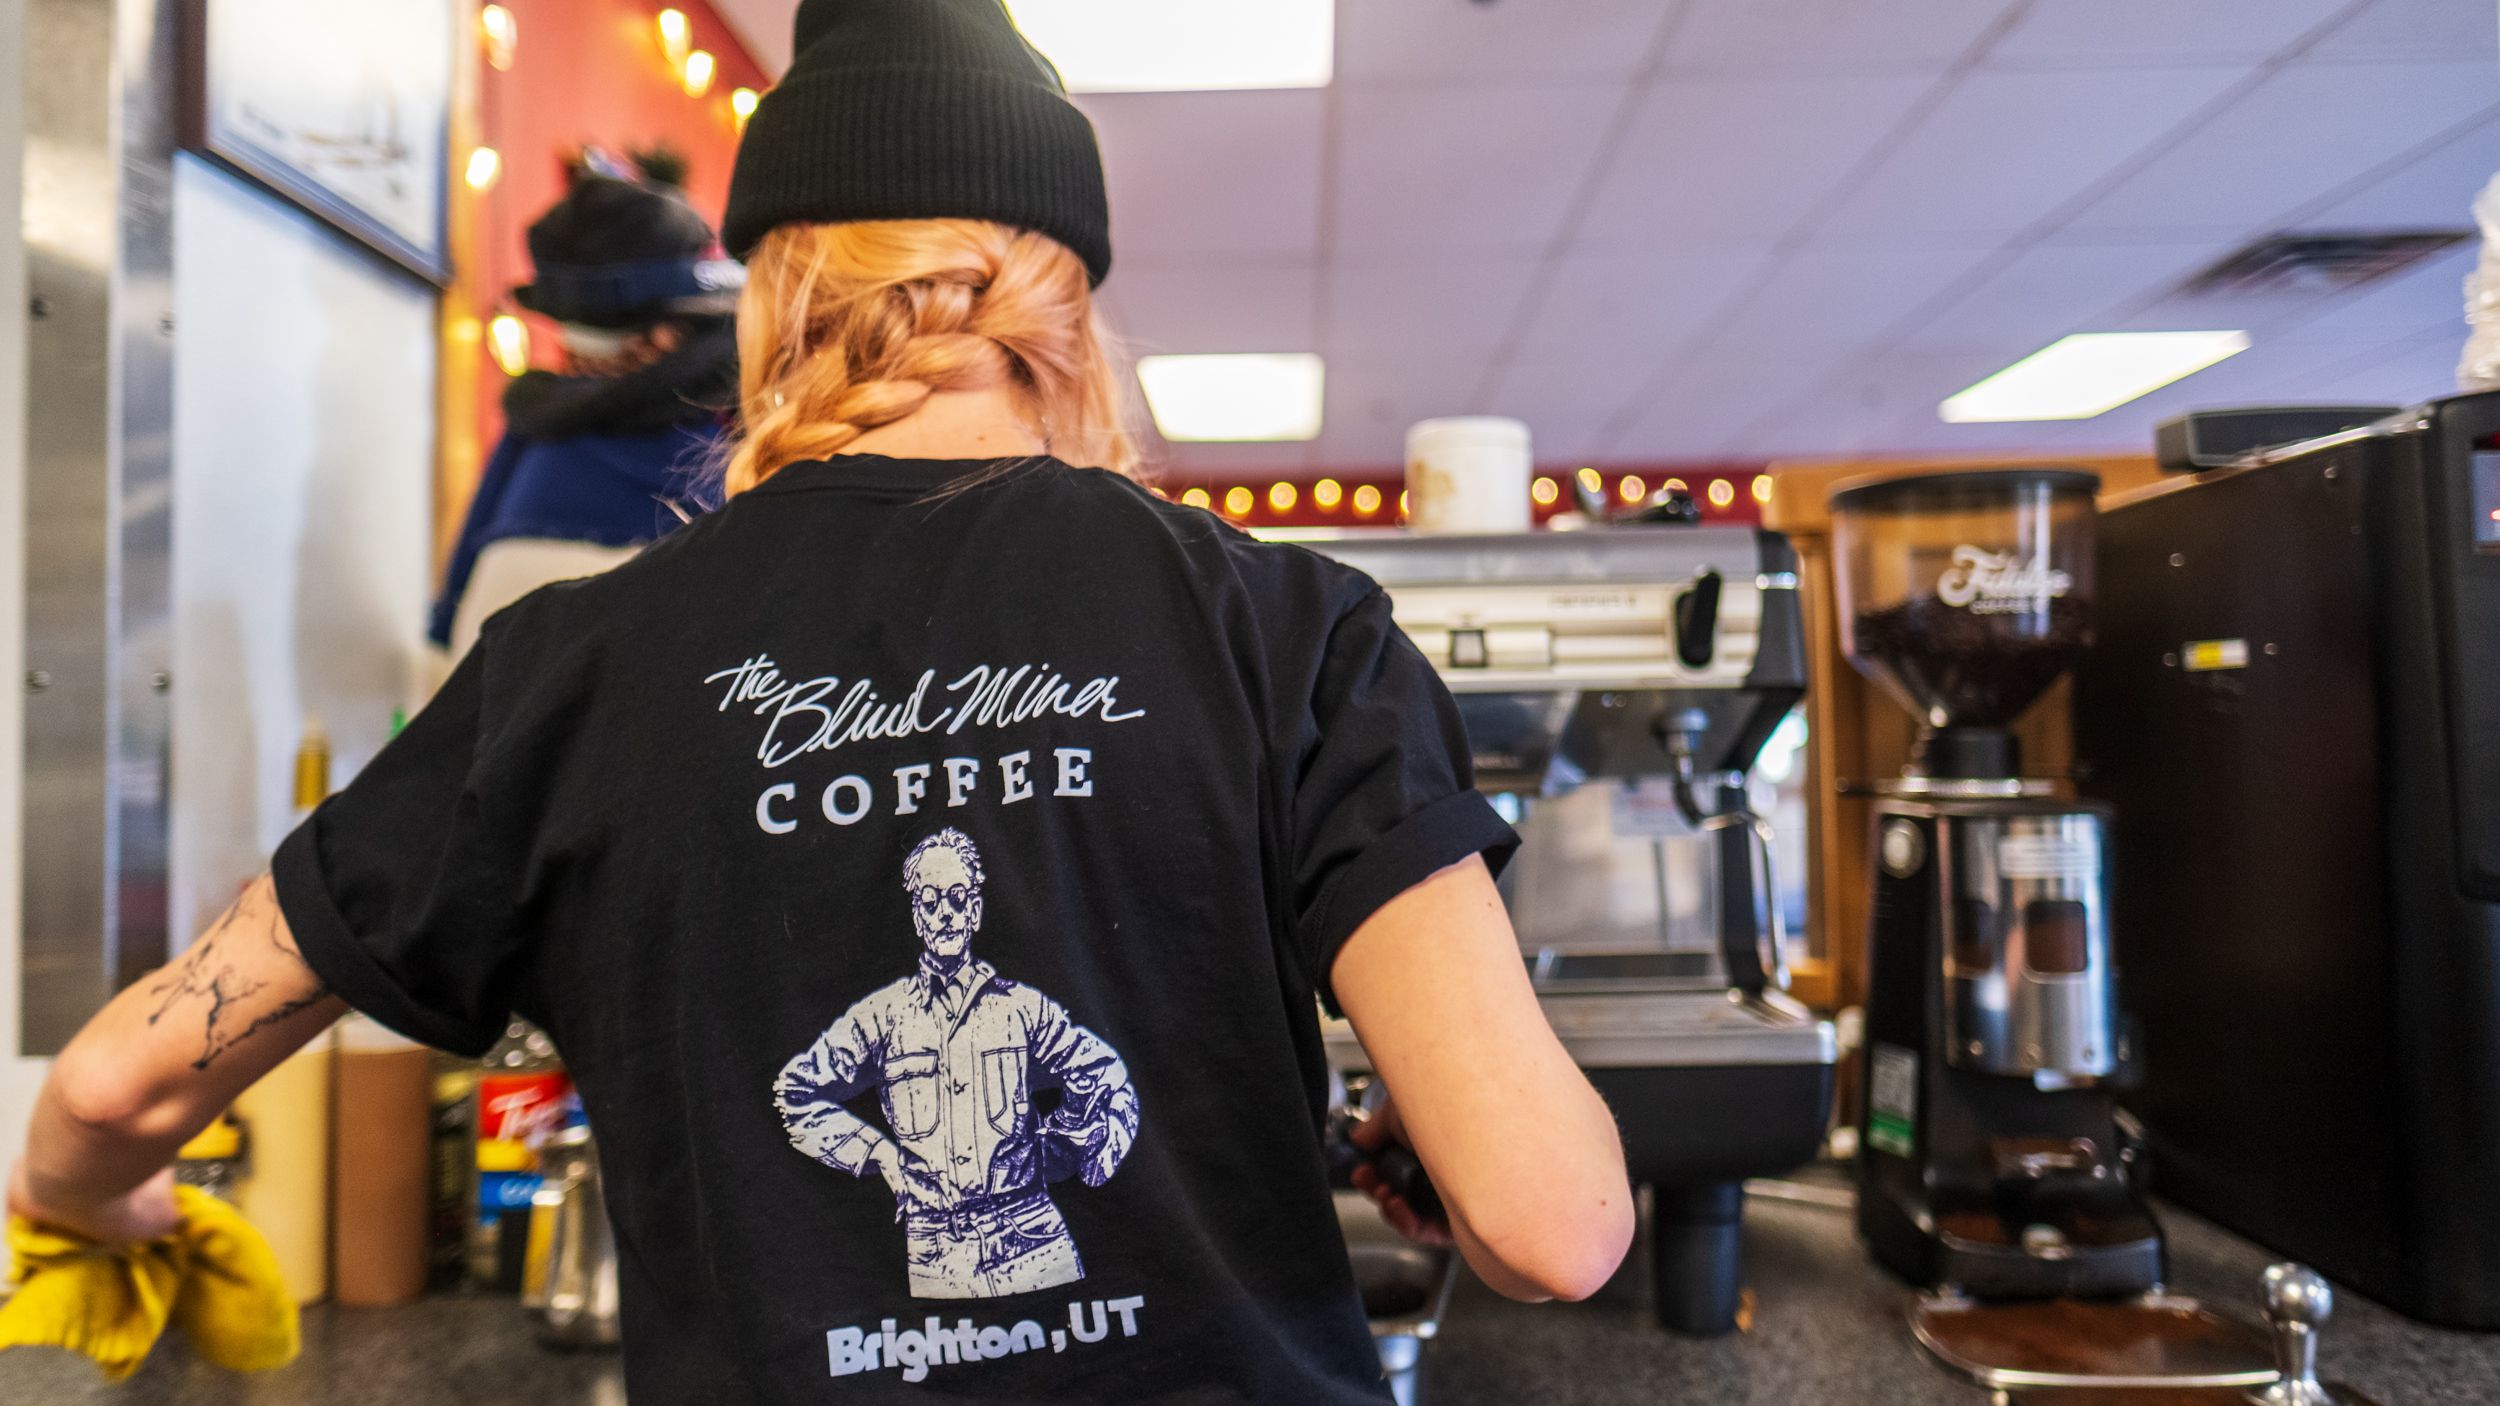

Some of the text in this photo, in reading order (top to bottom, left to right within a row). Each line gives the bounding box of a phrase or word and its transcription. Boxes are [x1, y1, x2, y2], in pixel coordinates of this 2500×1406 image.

[753, 668, 953, 769] Blind
[945, 662, 1147, 736] Miner
[755, 747, 1094, 835] COFFEE
